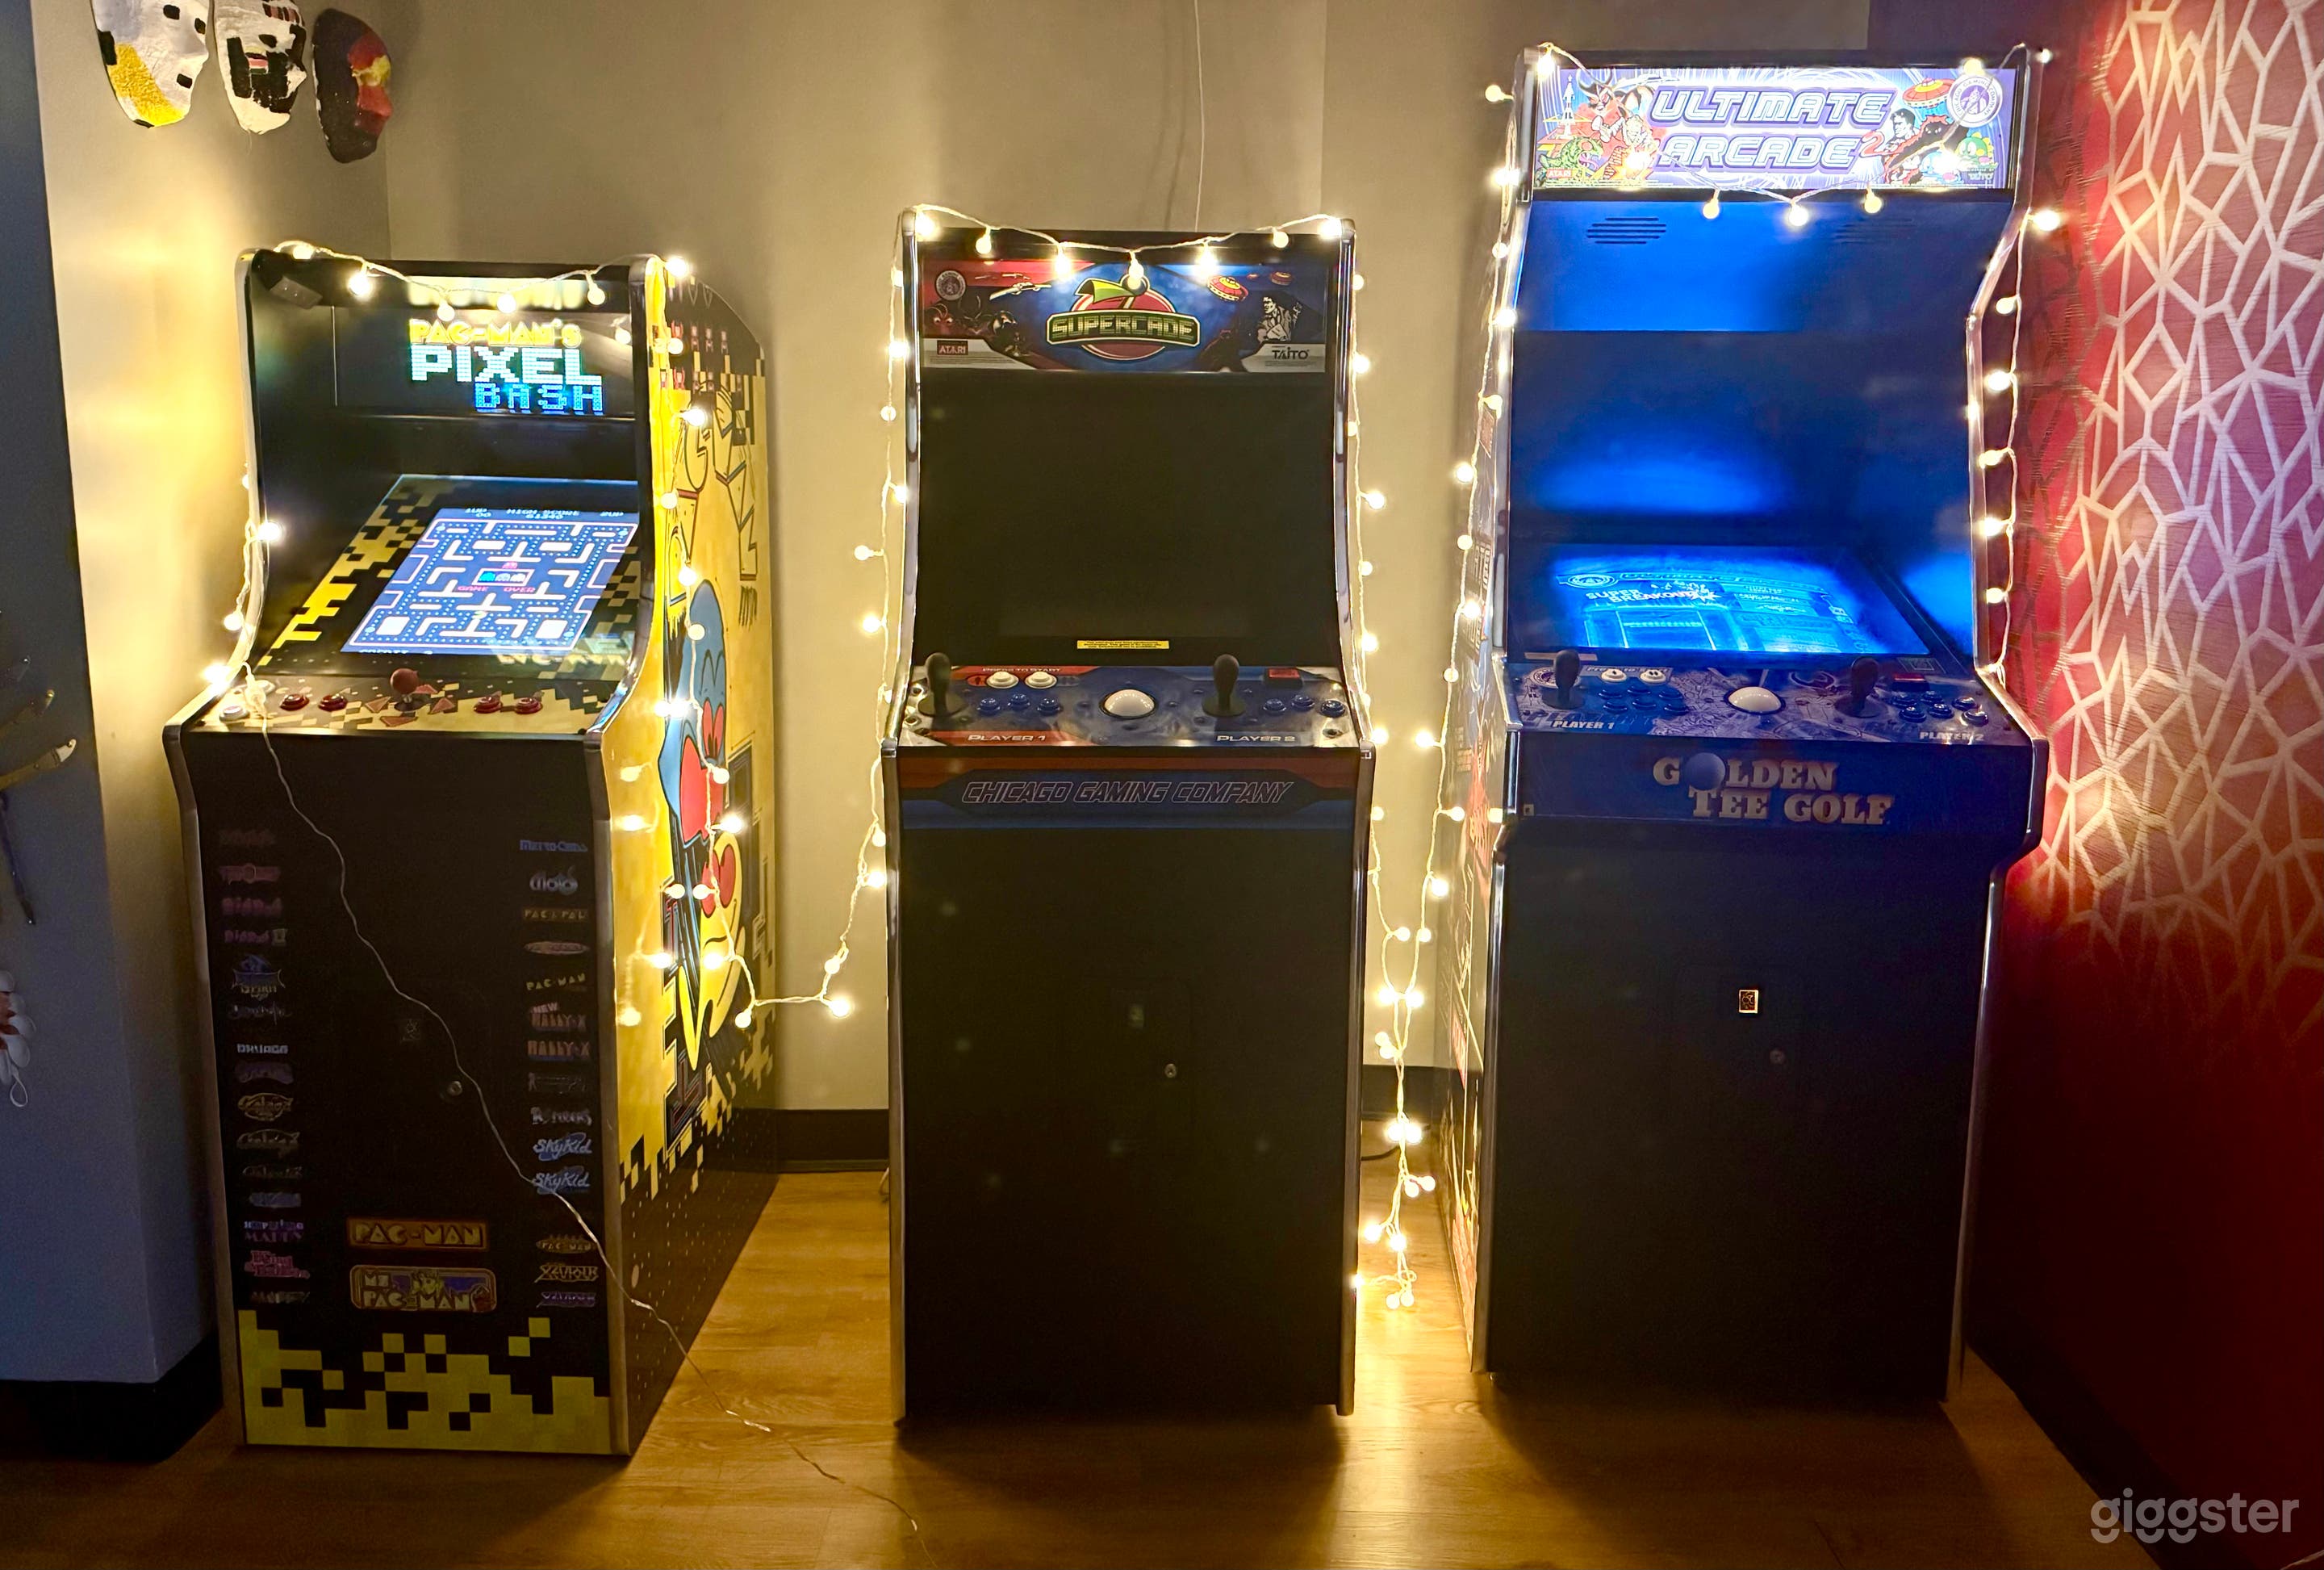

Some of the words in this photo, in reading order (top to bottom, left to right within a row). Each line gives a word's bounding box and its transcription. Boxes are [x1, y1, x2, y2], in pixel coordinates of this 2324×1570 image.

[1650, 89, 1895, 124] ULTIMATE
[1656, 134, 1864, 170] ARCADE
[1051, 314, 1195, 341] SUPERCADE
[938, 345, 966, 354] ATARI
[1272, 346, 1309, 360] TAITO
[411, 345, 602, 386] PIXEL
[474, 383, 604, 413] BASH
[1586, 588, 1641, 600] SUPER
[1552, 720, 1608, 729] PLAYER
[1607, 722, 1615, 730] 1
[961, 781, 1075, 804] CHICAGO
[1073, 781, 1172, 804] GAMING
[1171, 781, 1294, 804] COMPANY
[1688, 785, 1770, 819] TEE
[1783, 793, 1893, 825] GOLF
[355, 1223, 483, 1246] PAC-MAN
